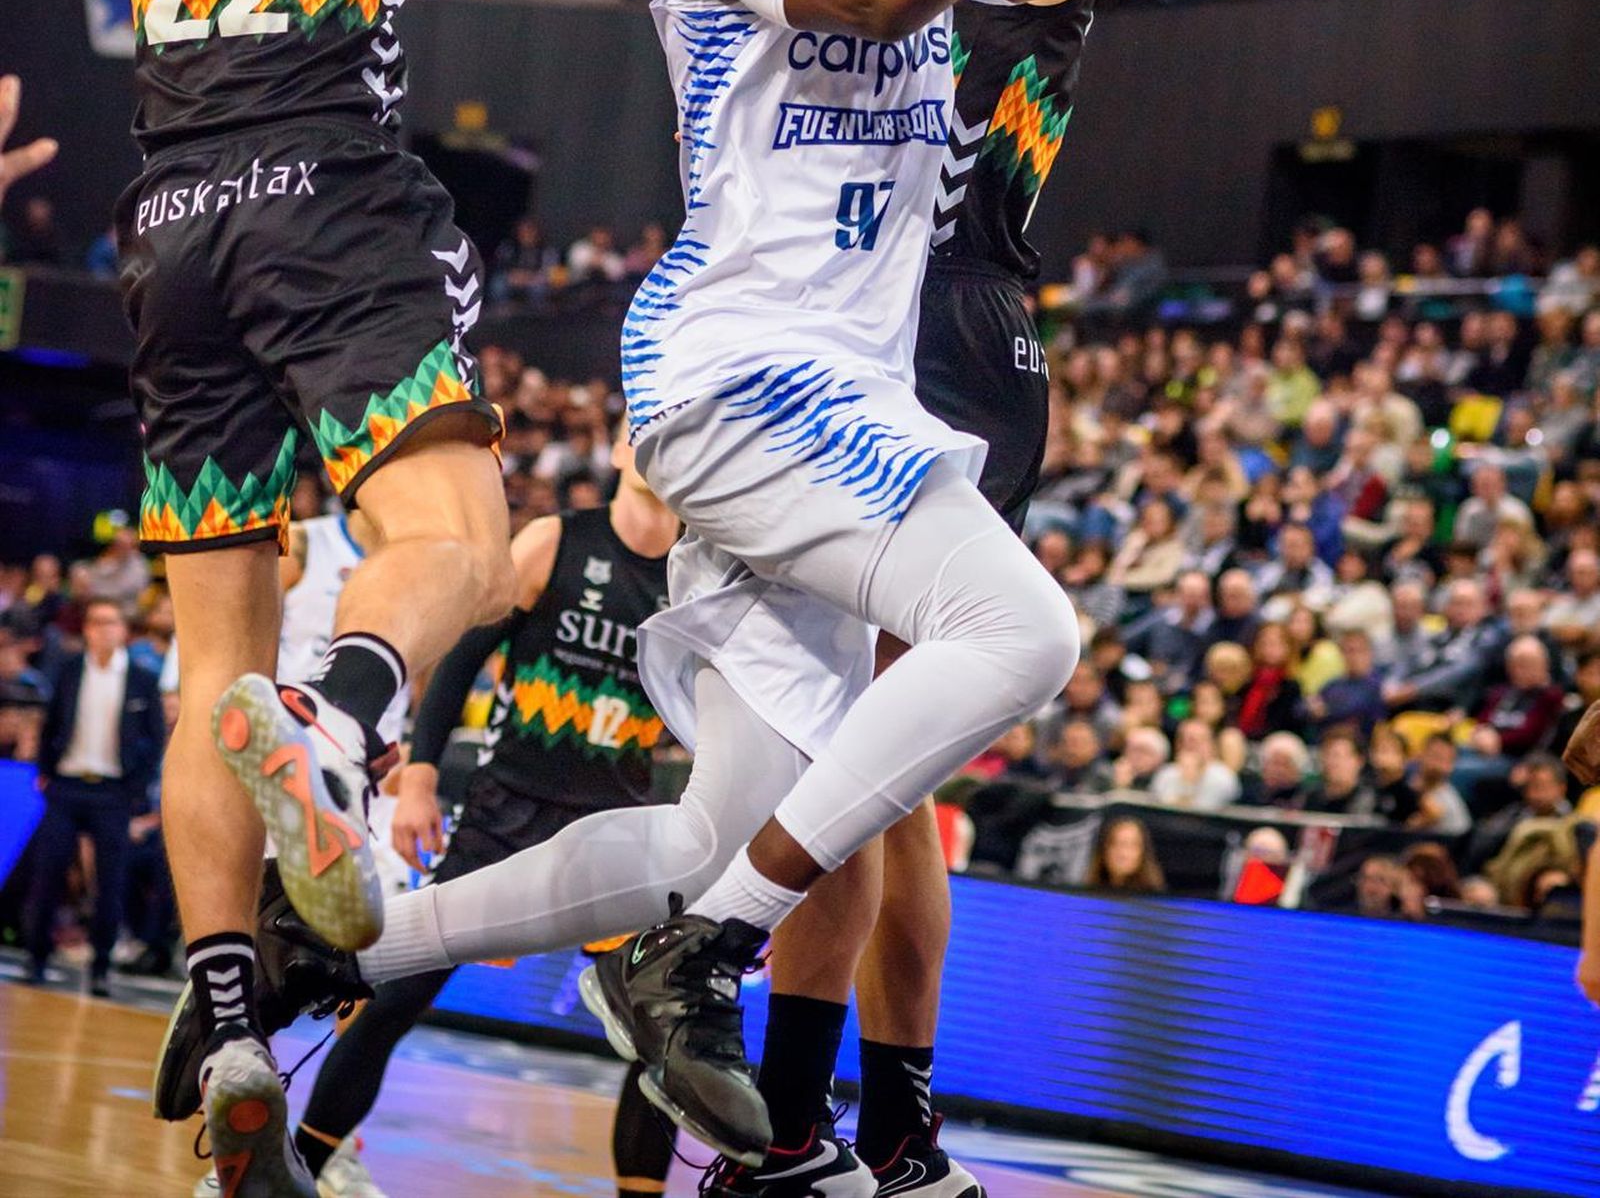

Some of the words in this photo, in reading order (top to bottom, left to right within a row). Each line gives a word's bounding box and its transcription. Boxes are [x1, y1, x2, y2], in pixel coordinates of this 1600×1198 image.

[834, 180, 896, 252] 97
[556, 610, 638, 663] sur
[587, 694, 630, 748] 12
